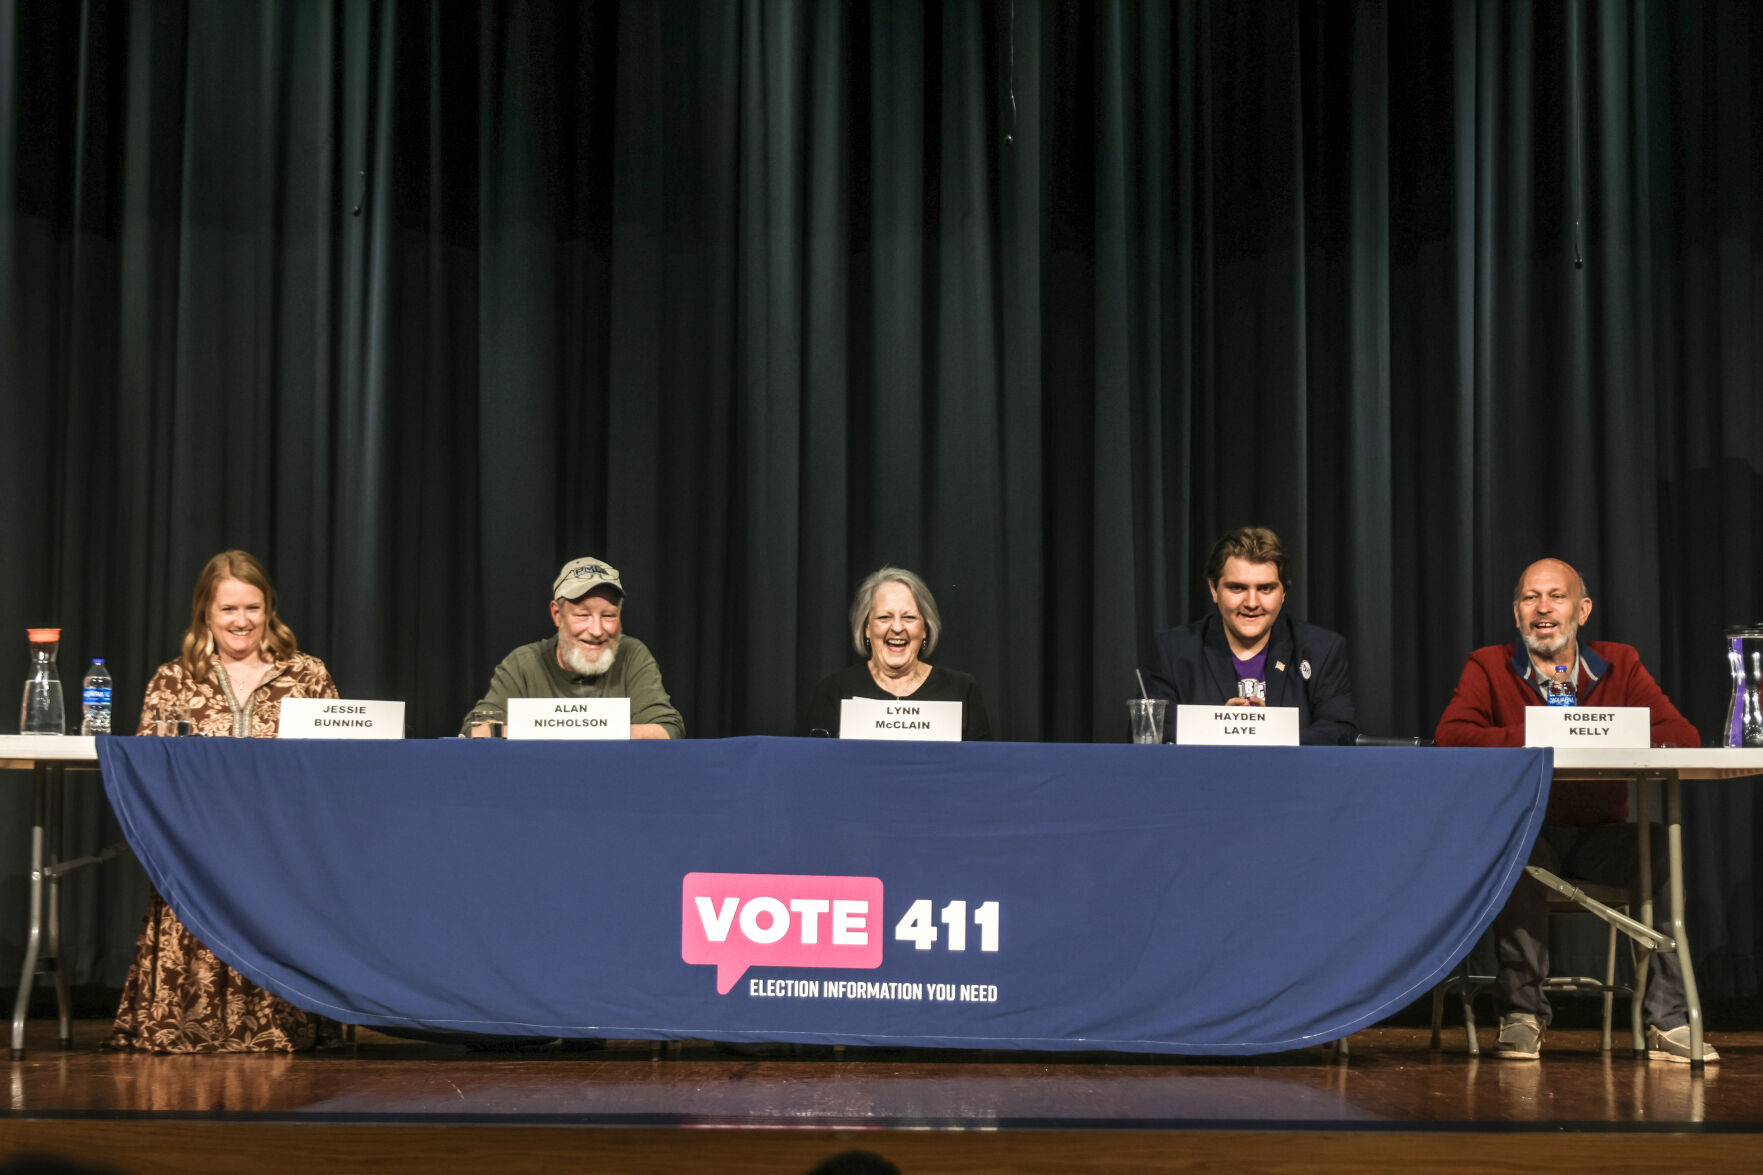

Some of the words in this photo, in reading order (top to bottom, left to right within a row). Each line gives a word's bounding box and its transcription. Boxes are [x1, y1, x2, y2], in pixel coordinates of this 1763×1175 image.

[323, 705, 367, 714] JESSIE
[554, 704, 588, 713] ALAN
[886, 706, 920, 715] LYNN
[1214, 712, 1266, 721] HAYDEN
[1564, 713, 1615, 722] ROBERT
[314, 718, 373, 728] BUNNING
[534, 718, 608, 727] NICHOLSON
[875, 720, 931, 730] McCLAIN
[1224, 726, 1256, 735] LAYE
[1569, 727, 1610, 736] KELLY
[694, 896, 869, 946] VOTE
[895, 899, 1000, 952] 411
[750, 979, 819, 999] ELECTION
[823, 980, 923, 1001] INFORMATION
[926, 983, 957, 1002] YOU
[960, 984, 998, 1002] NEED
